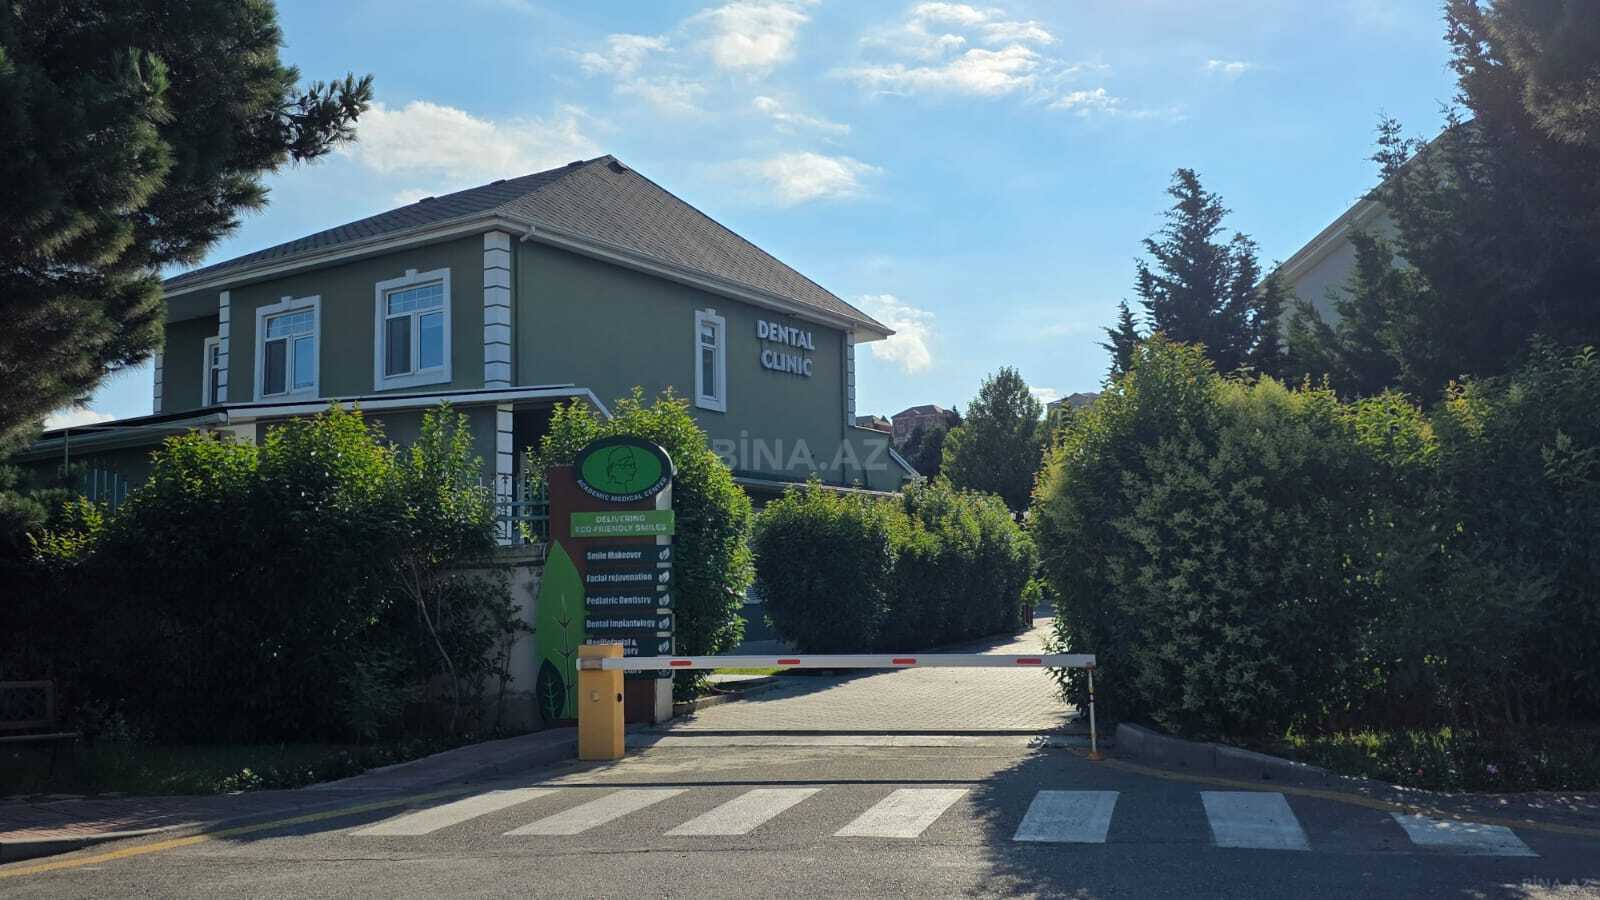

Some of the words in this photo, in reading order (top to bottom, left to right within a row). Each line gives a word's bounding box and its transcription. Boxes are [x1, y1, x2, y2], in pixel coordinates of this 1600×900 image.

[756, 319, 815, 351] DENTAL
[760, 348, 813, 377] CLINIC
[576, 479, 609, 501] ACADEMIC
[610, 493, 644, 502] MEDICAL
[644, 476, 668, 497] CENTER
[595, 514, 646, 523] DELIVERING
[634, 523, 667, 532] SMILES
[586, 551, 607, 560] Smile
[607, 551, 642, 560] Makeover
[586, 574, 607, 583] Facial
[608, 573, 653, 583] rejuvenation
[586, 596, 618, 605] Pediatric
[619, 596, 652, 605] Dentistry
[586, 619, 609, 628] Dental
[610, 619, 656, 629] Implantology
